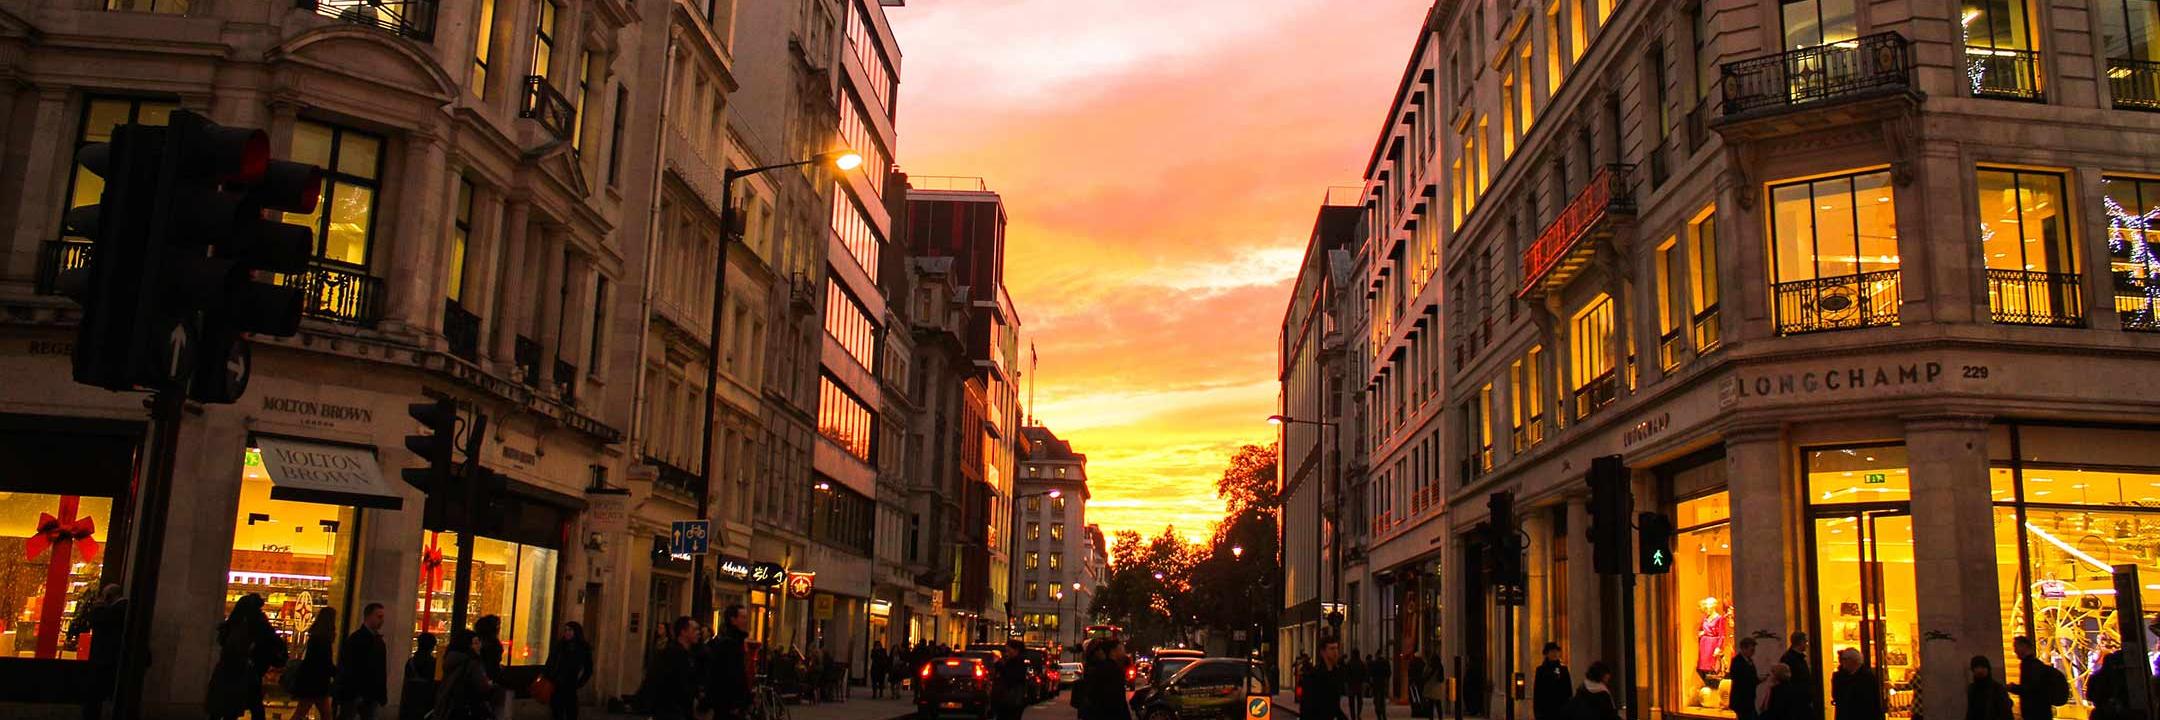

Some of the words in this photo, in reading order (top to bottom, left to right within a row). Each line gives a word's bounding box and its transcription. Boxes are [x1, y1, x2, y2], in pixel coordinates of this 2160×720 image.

[1738, 362, 1942, 397] LONGCHAMP
[1962, 365, 1989, 379] 229
[263, 396, 318, 416] MOLTON
[320, 403, 374, 423] BROWN
[275, 447, 362, 470] MOLTON
[280, 464, 370, 484] BROWN
